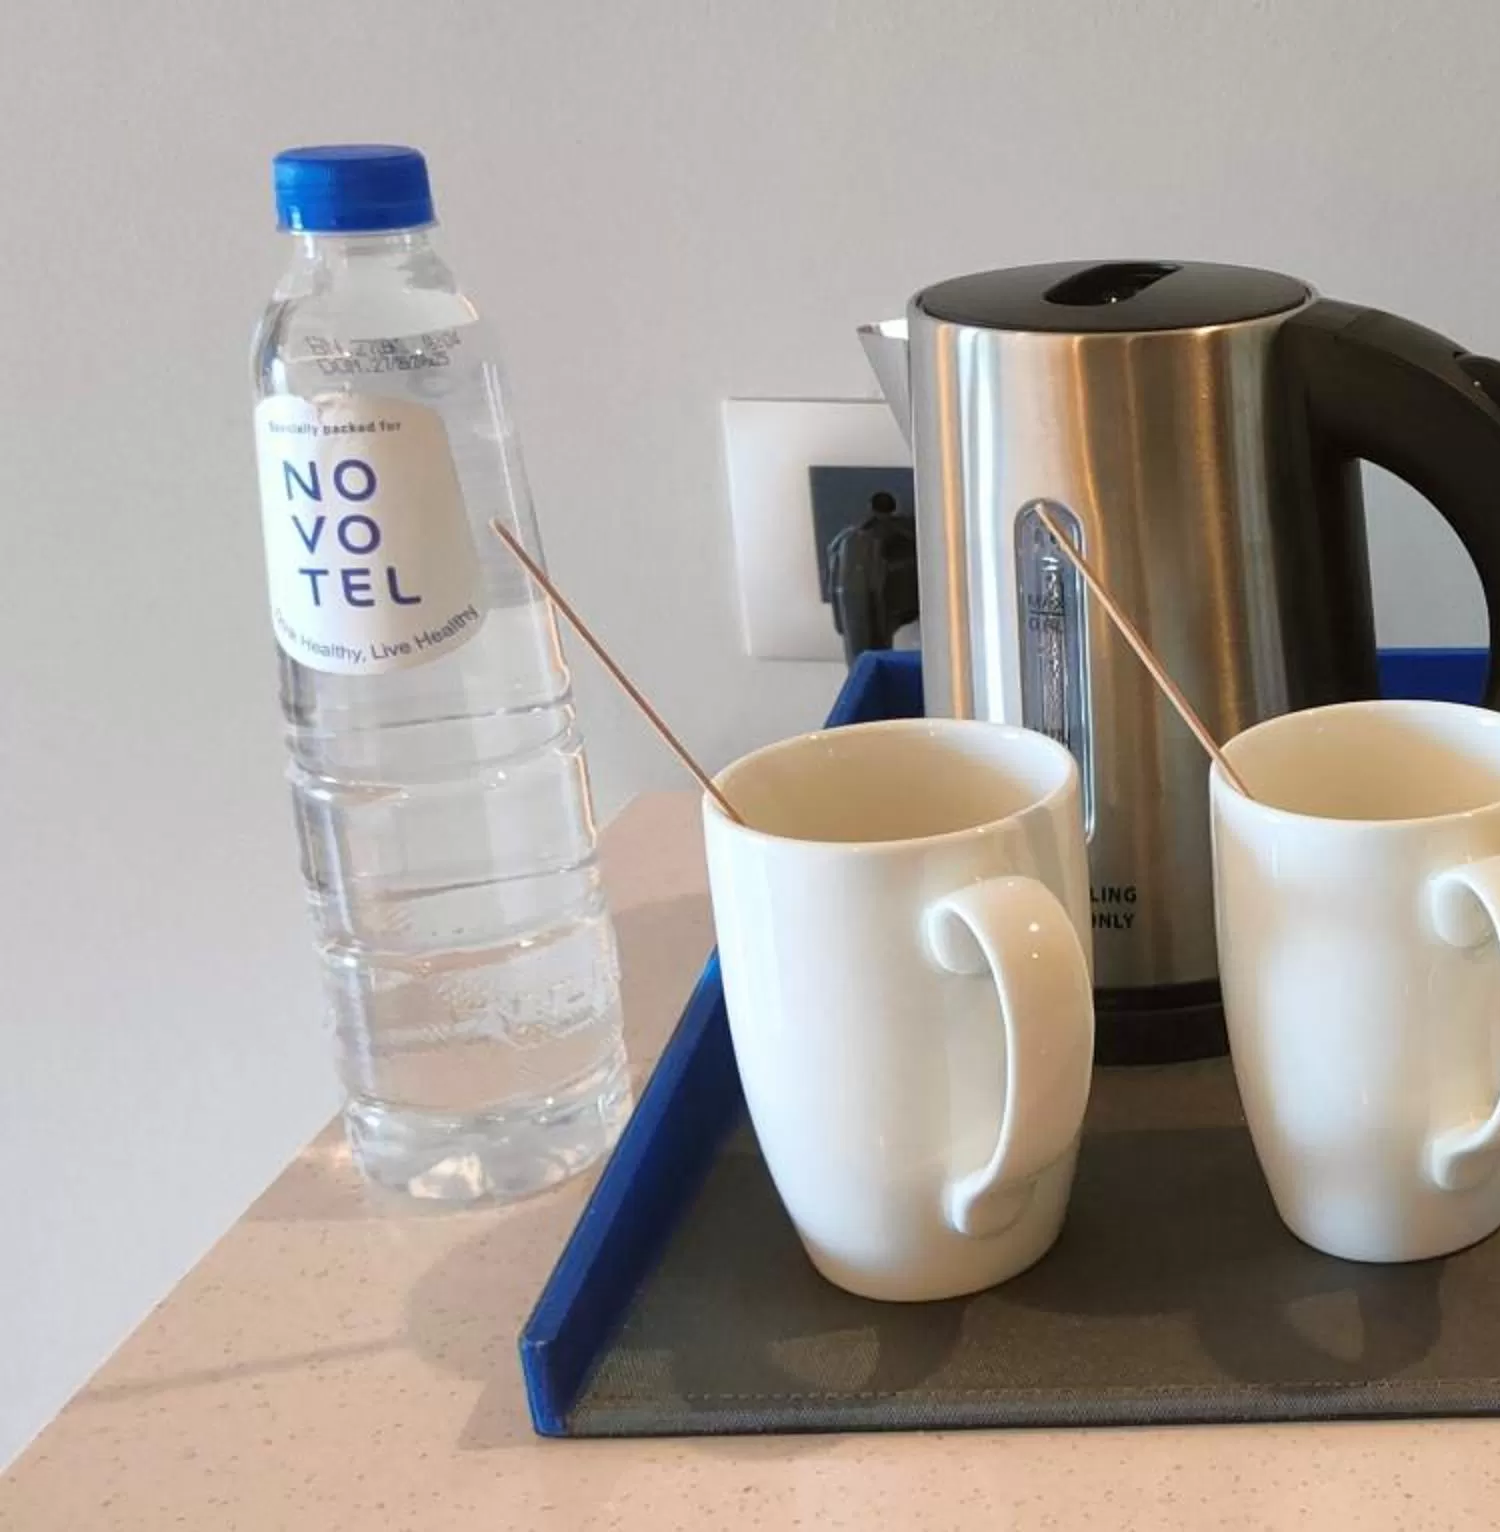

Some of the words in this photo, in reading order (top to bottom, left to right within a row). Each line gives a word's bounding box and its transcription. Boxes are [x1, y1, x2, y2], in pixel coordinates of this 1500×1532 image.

[323, 420, 376, 436] packed
[378, 419, 402, 433] for
[282, 459, 377, 502] NO
[291, 514, 382, 556] VO
[298, 566, 422, 607] TEL
[371, 641, 412, 660] Live
[414, 604, 480, 650] Healthy
[1089, 886, 1138, 904] LING
